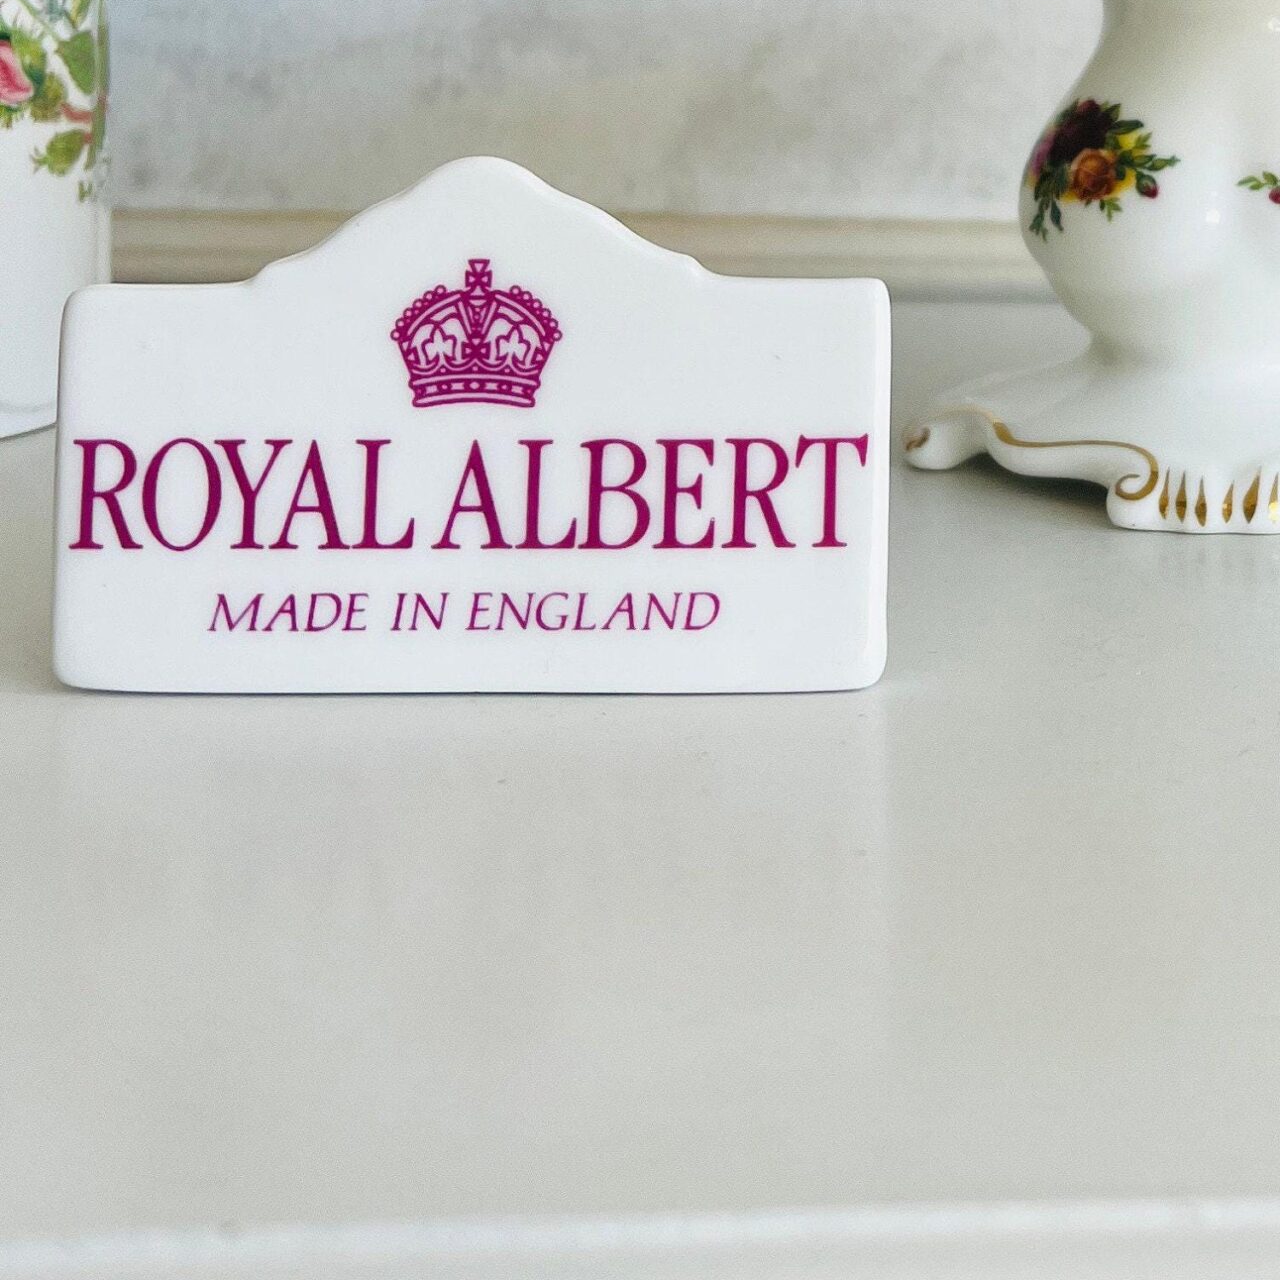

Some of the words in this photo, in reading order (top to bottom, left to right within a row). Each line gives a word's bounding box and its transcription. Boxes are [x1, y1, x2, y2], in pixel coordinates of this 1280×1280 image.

[68, 437, 417, 552] ROYAL
[432, 433, 870, 551] ALBERT
[208, 592, 368, 633] MADE
[391, 592, 449, 632] IN
[465, 591, 722, 632] ENGLAND
